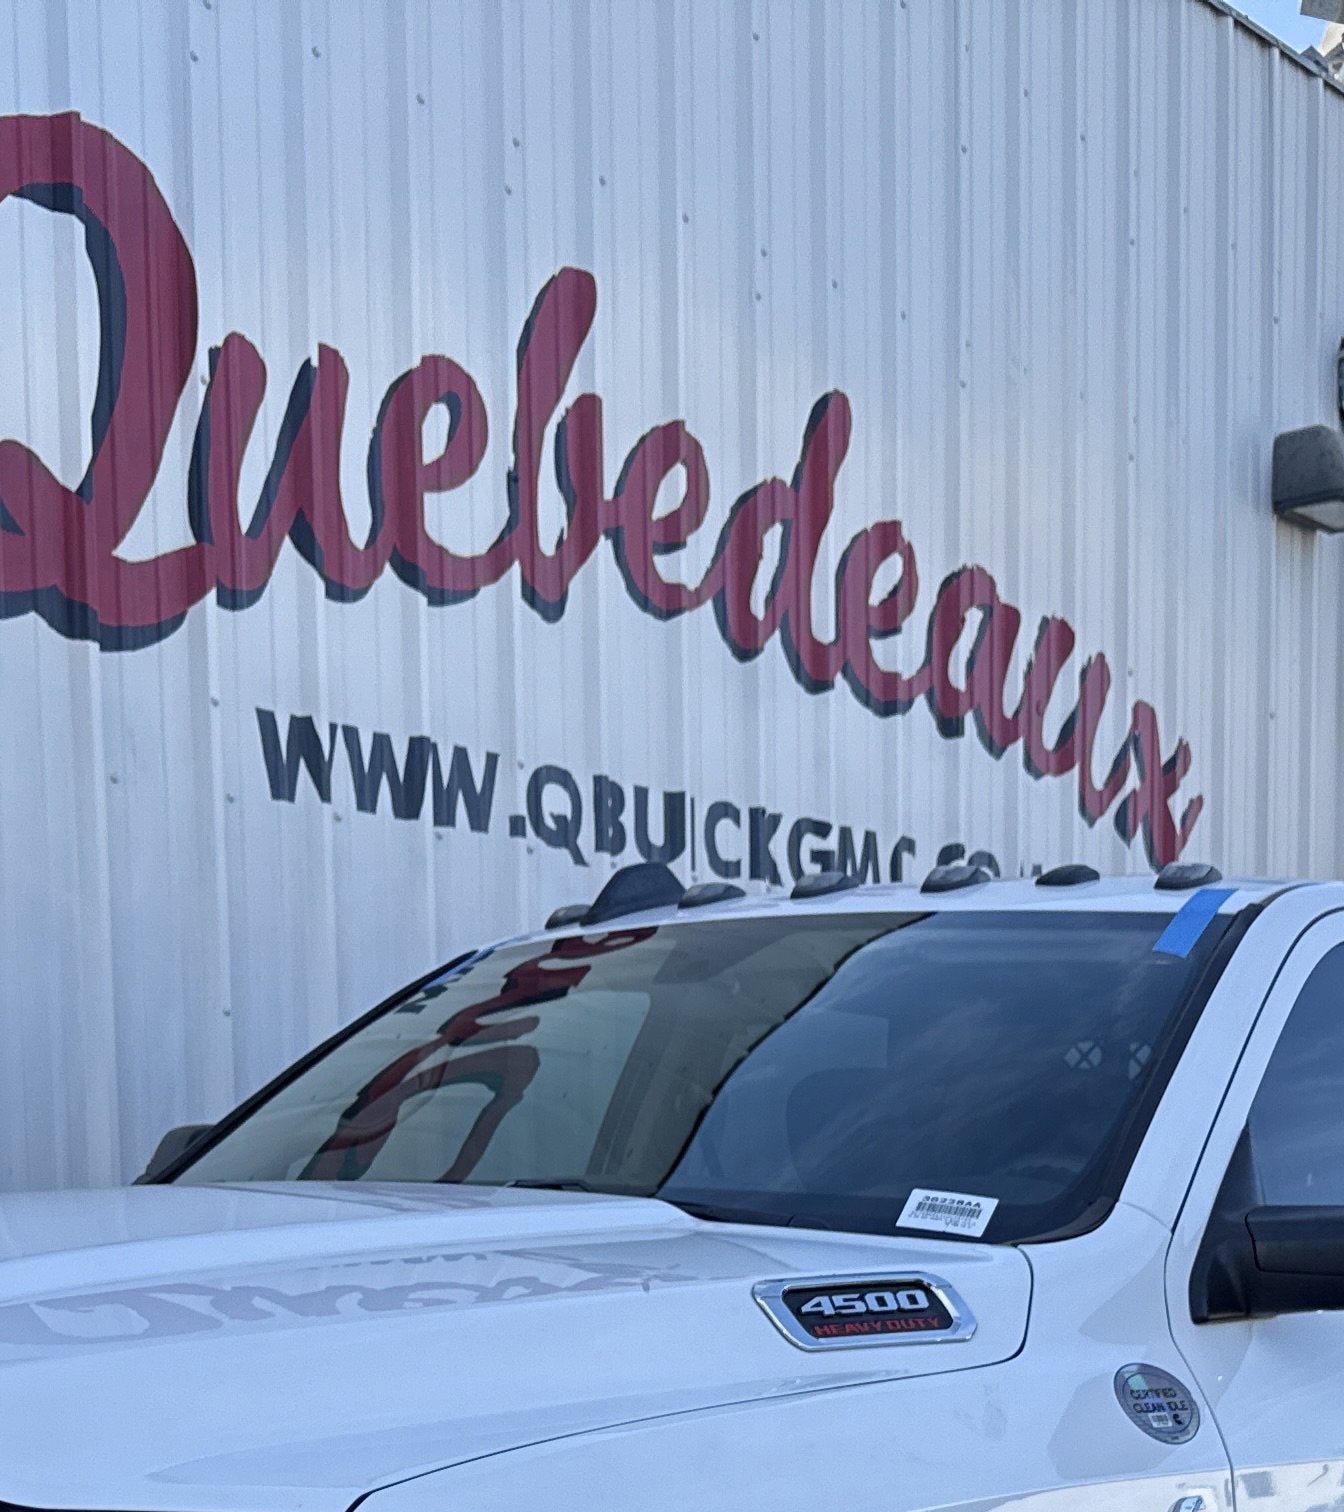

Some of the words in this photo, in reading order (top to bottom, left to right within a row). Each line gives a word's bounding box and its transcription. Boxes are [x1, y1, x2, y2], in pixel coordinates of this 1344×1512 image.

[254, 706, 1044, 886] WWW.QBUICKGMC
[800, 1289, 930, 1317] 4500
[814, 1320, 881, 1336] HEAVY
[885, 1316, 941, 1331] DUTY
[1133, 1402, 1166, 1413] CLEAN
